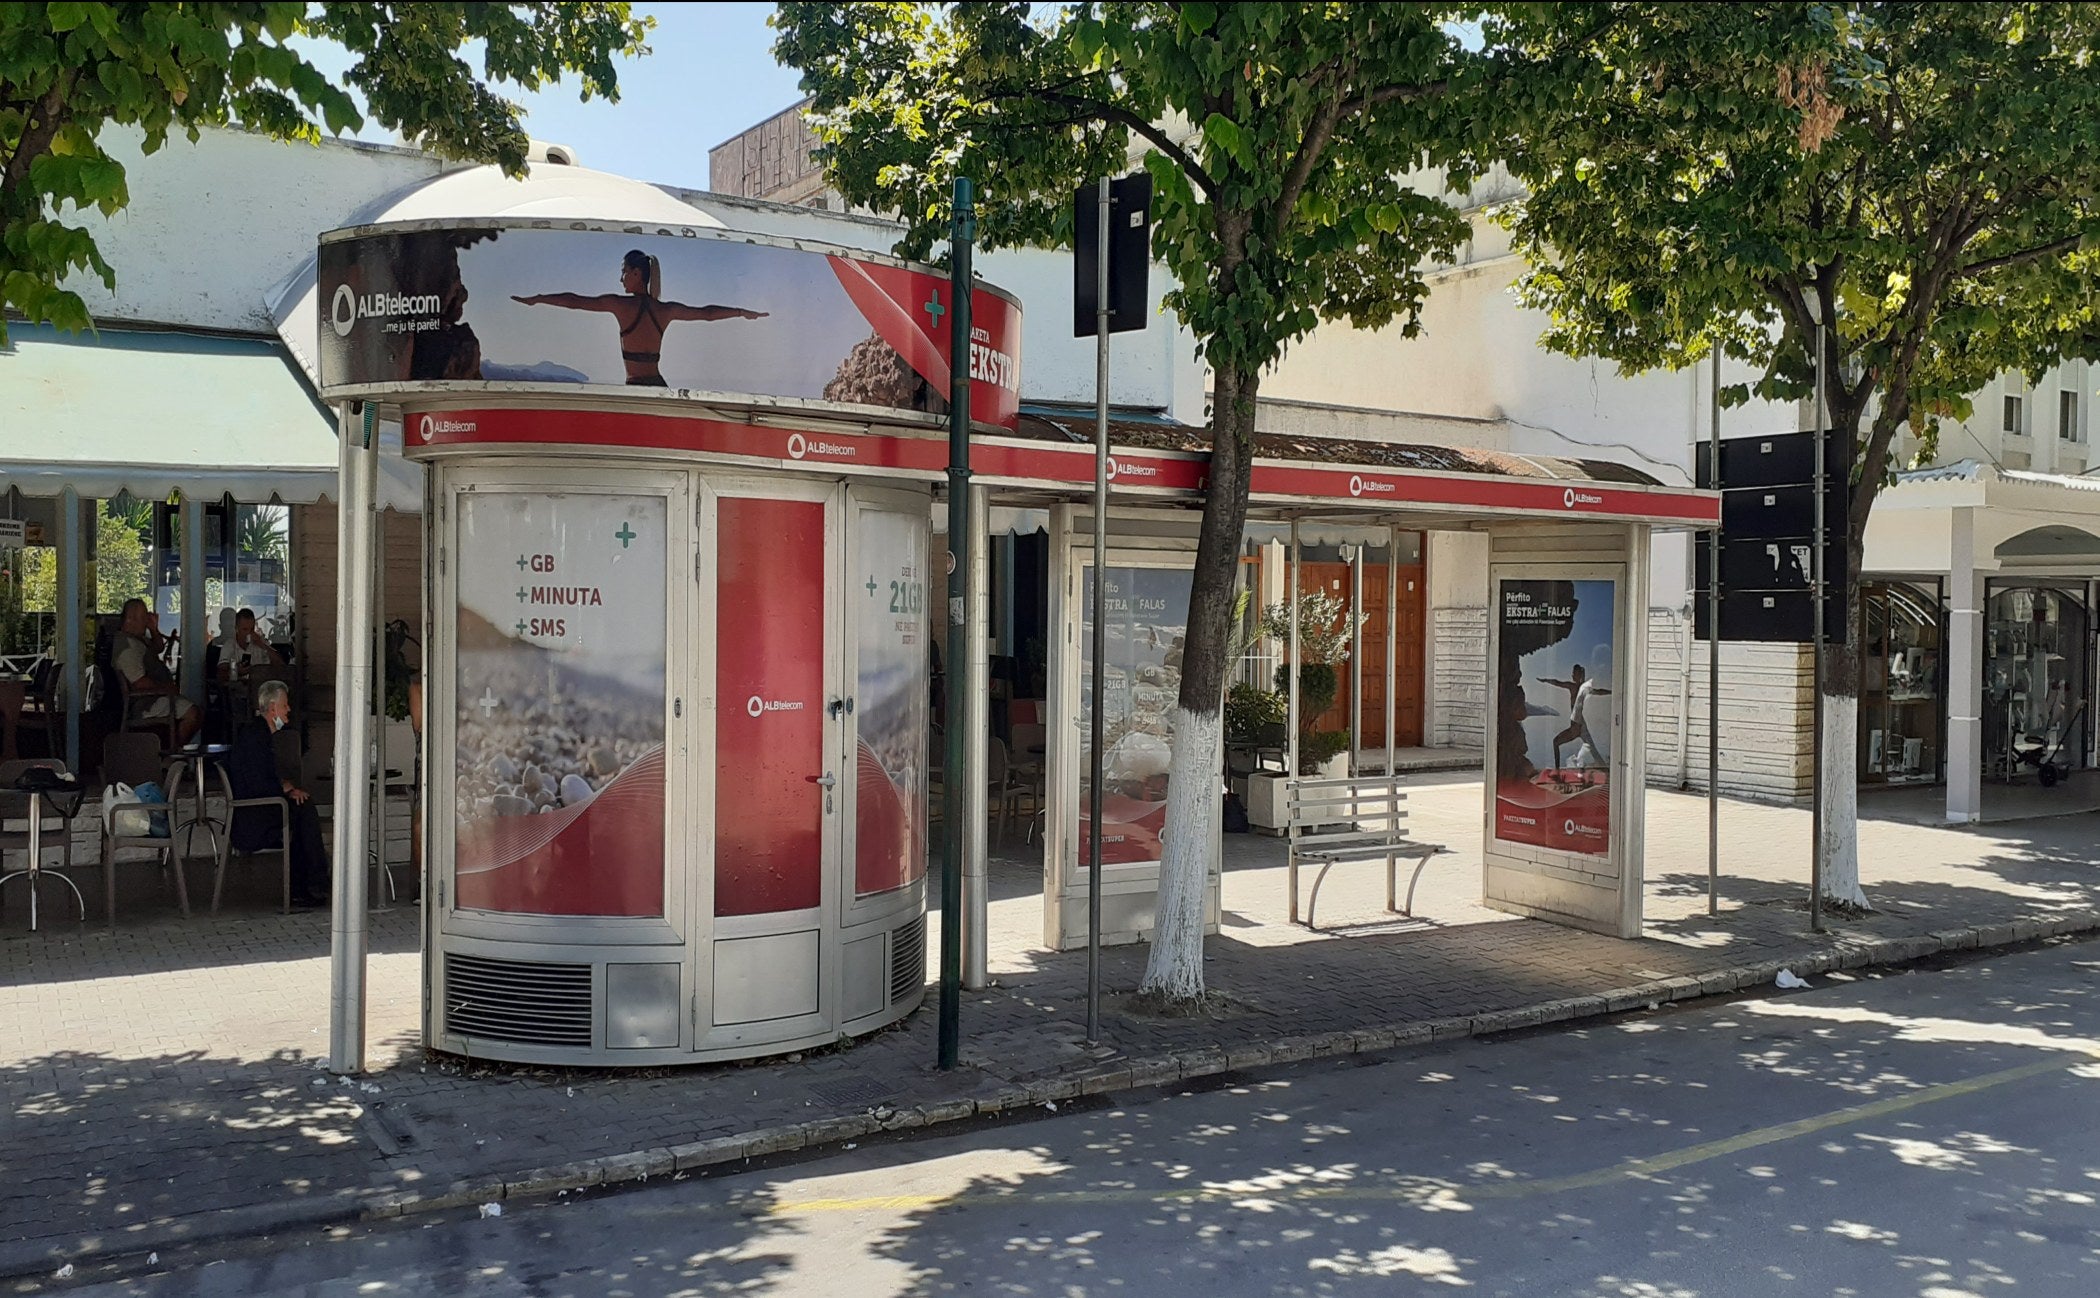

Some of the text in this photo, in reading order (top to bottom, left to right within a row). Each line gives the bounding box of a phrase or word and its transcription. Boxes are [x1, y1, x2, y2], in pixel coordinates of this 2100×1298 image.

[357, 291, 440, 319] ALBtelecom
[399, 320, 407, 335] ju
[408, 319, 416, 331] të
[416, 318, 440, 334] parët!
[970, 326, 990, 344] AKETA
[434, 420, 477, 433] ALBtelecom
[807, 441, 856, 456] ALBtelecom
[1117, 463, 1156, 476] ALBtelecom
[1362, 480, 1396, 492] ALBtelecom
[1574, 493, 1603, 504] ALBtelecom
[1505, 591, 1531, 603] Përfito
[1139, 599, 1166, 610] FALAS
[1505, 606, 1571, 618] EKSTRA FALAS
[1144, 666, 1156, 677] GB
[1107, 679, 1126, 689] 21GB
[763, 700, 804, 711] ALBtelecom
